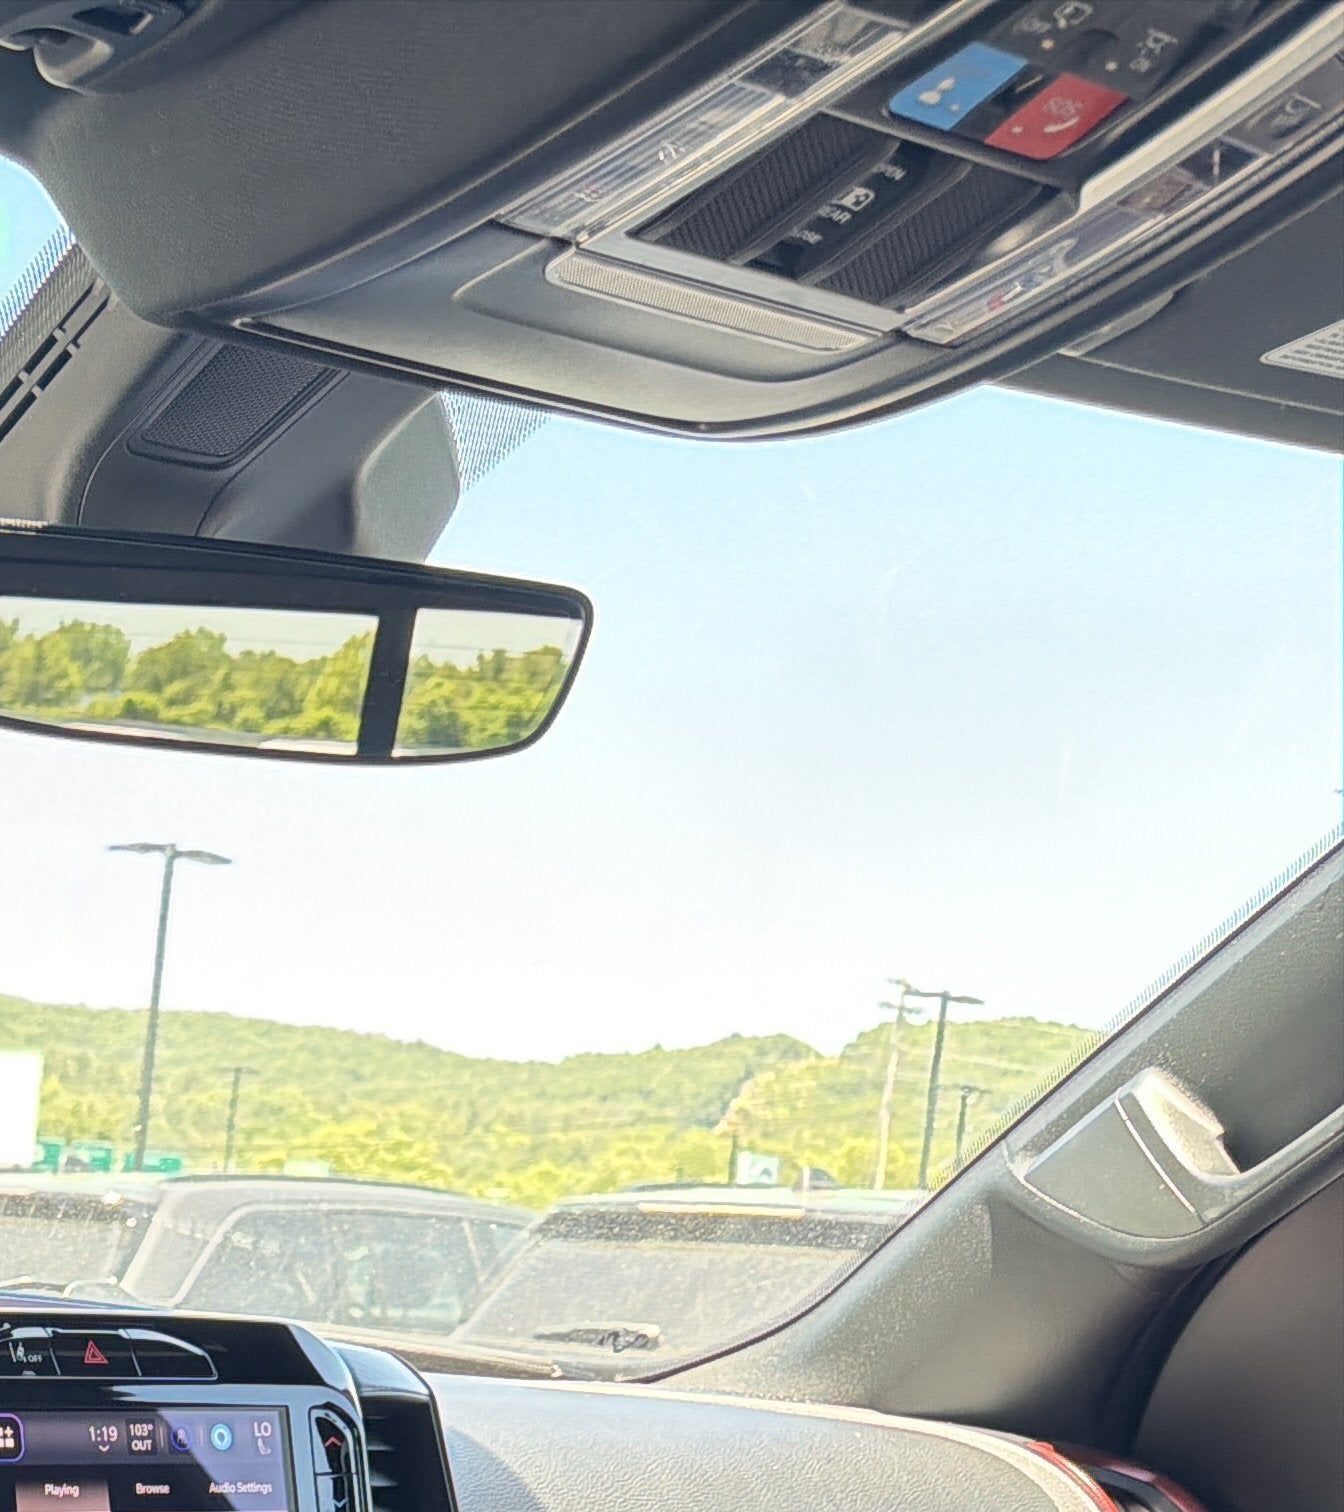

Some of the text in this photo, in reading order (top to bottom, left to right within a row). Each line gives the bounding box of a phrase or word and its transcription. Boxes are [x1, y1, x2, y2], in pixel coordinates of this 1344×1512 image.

[27, 1354, 43, 1363] OFF
[88, 1425, 118, 1442] 1:19
[254, 1421, 272, 1437] LO
[132, 1439, 152, 1451] OUT
[44, 1483, 80, 1498] Playing
[135, 1482, 171, 1495] Browse
[209, 1482, 273, 1495] Audio Settings
